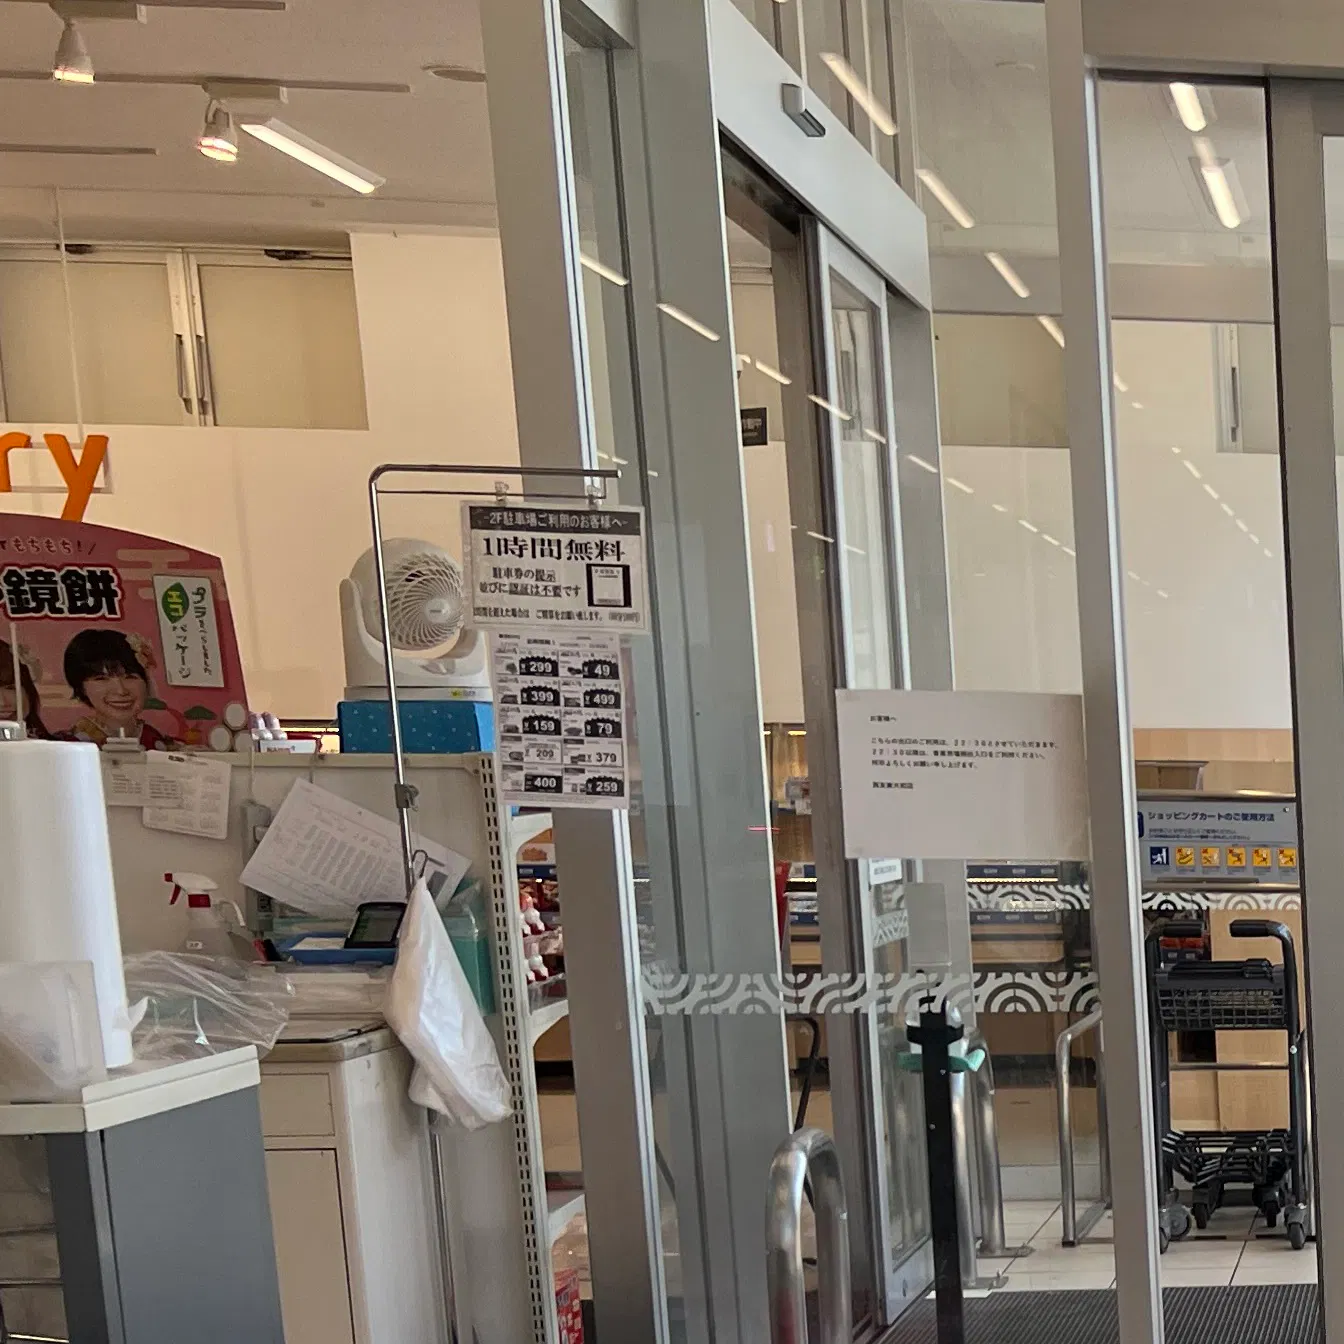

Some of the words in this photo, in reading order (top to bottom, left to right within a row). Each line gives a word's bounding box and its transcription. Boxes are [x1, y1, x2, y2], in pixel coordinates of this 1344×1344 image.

[482, 536, 626, 562] 1時間無料
[3, 568, 121, 617] 鏡餅
[167, 590, 183, 617] エコ
[529, 661, 553, 673] 299
[594, 664, 611, 676] 49
[531, 690, 554, 702] 399
[593, 693, 616, 706] 499
[533, 719, 555, 731] 159
[597, 722, 613, 734] 79
[596, 752, 617, 763] 379
[534, 777, 557, 788] 400
[596, 780, 618, 793] 259
